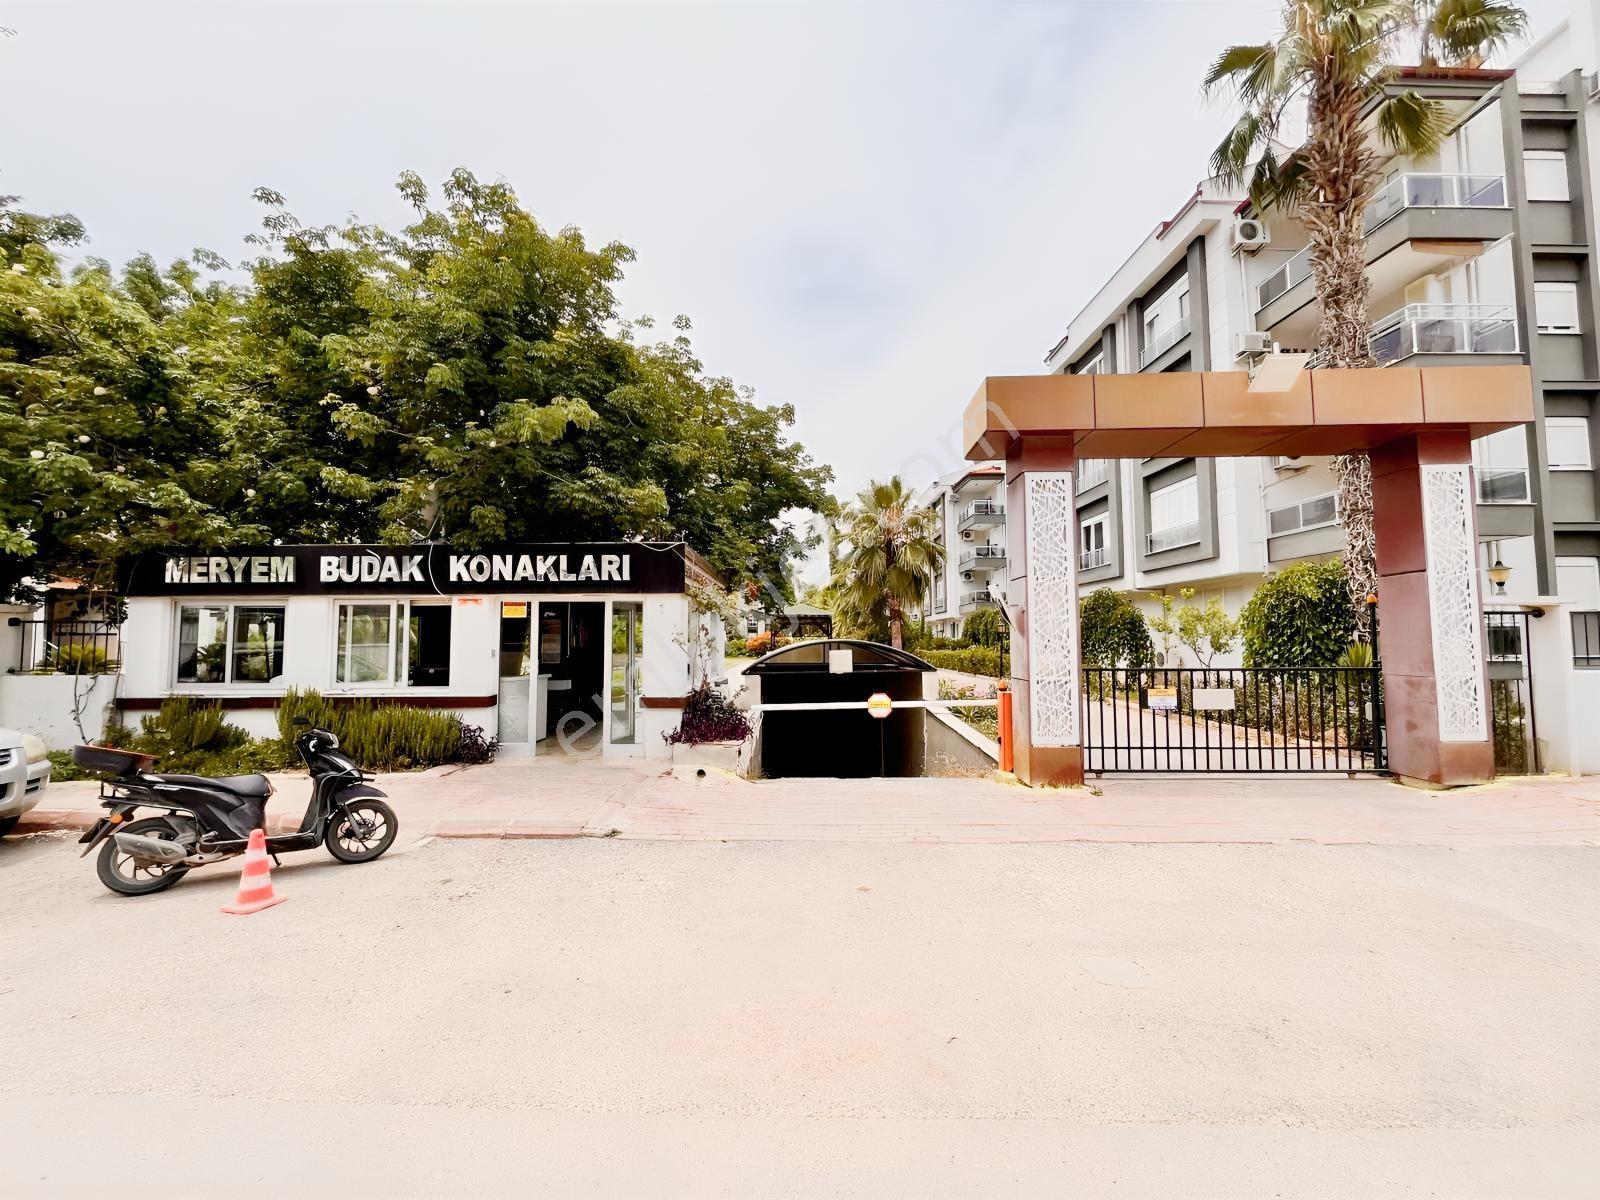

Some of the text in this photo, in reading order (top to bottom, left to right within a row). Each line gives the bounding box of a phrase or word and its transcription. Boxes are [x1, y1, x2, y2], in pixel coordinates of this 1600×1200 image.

[165, 554, 631, 583] MERYEM BUDAK KONAKLARI
